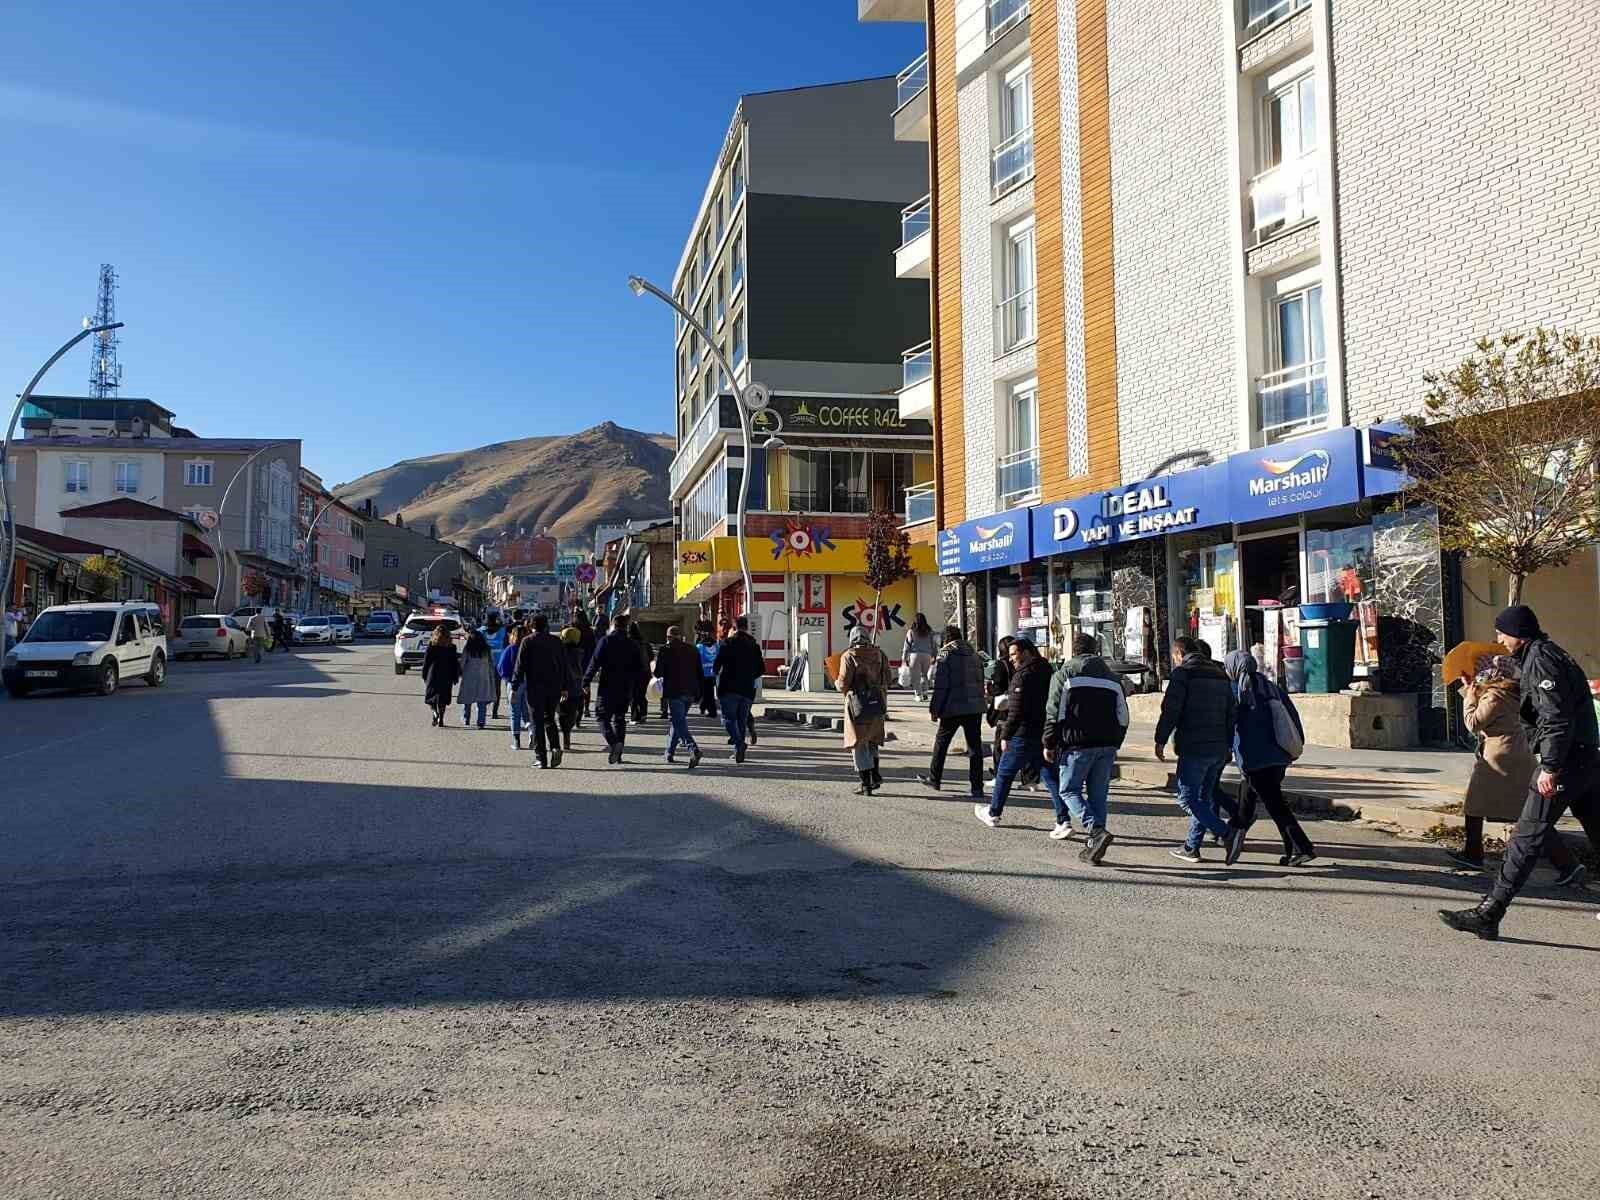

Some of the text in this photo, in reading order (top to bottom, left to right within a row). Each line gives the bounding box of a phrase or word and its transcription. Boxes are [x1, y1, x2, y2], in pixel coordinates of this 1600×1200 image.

[819, 406, 869, 427] COFFEE
[1250, 466, 1324, 497] Marshall
[1053, 507, 1076, 541] D
[1080, 506, 1195, 543] YAPI VE İNŞAAT
[968, 534, 1010, 554] Marshall
